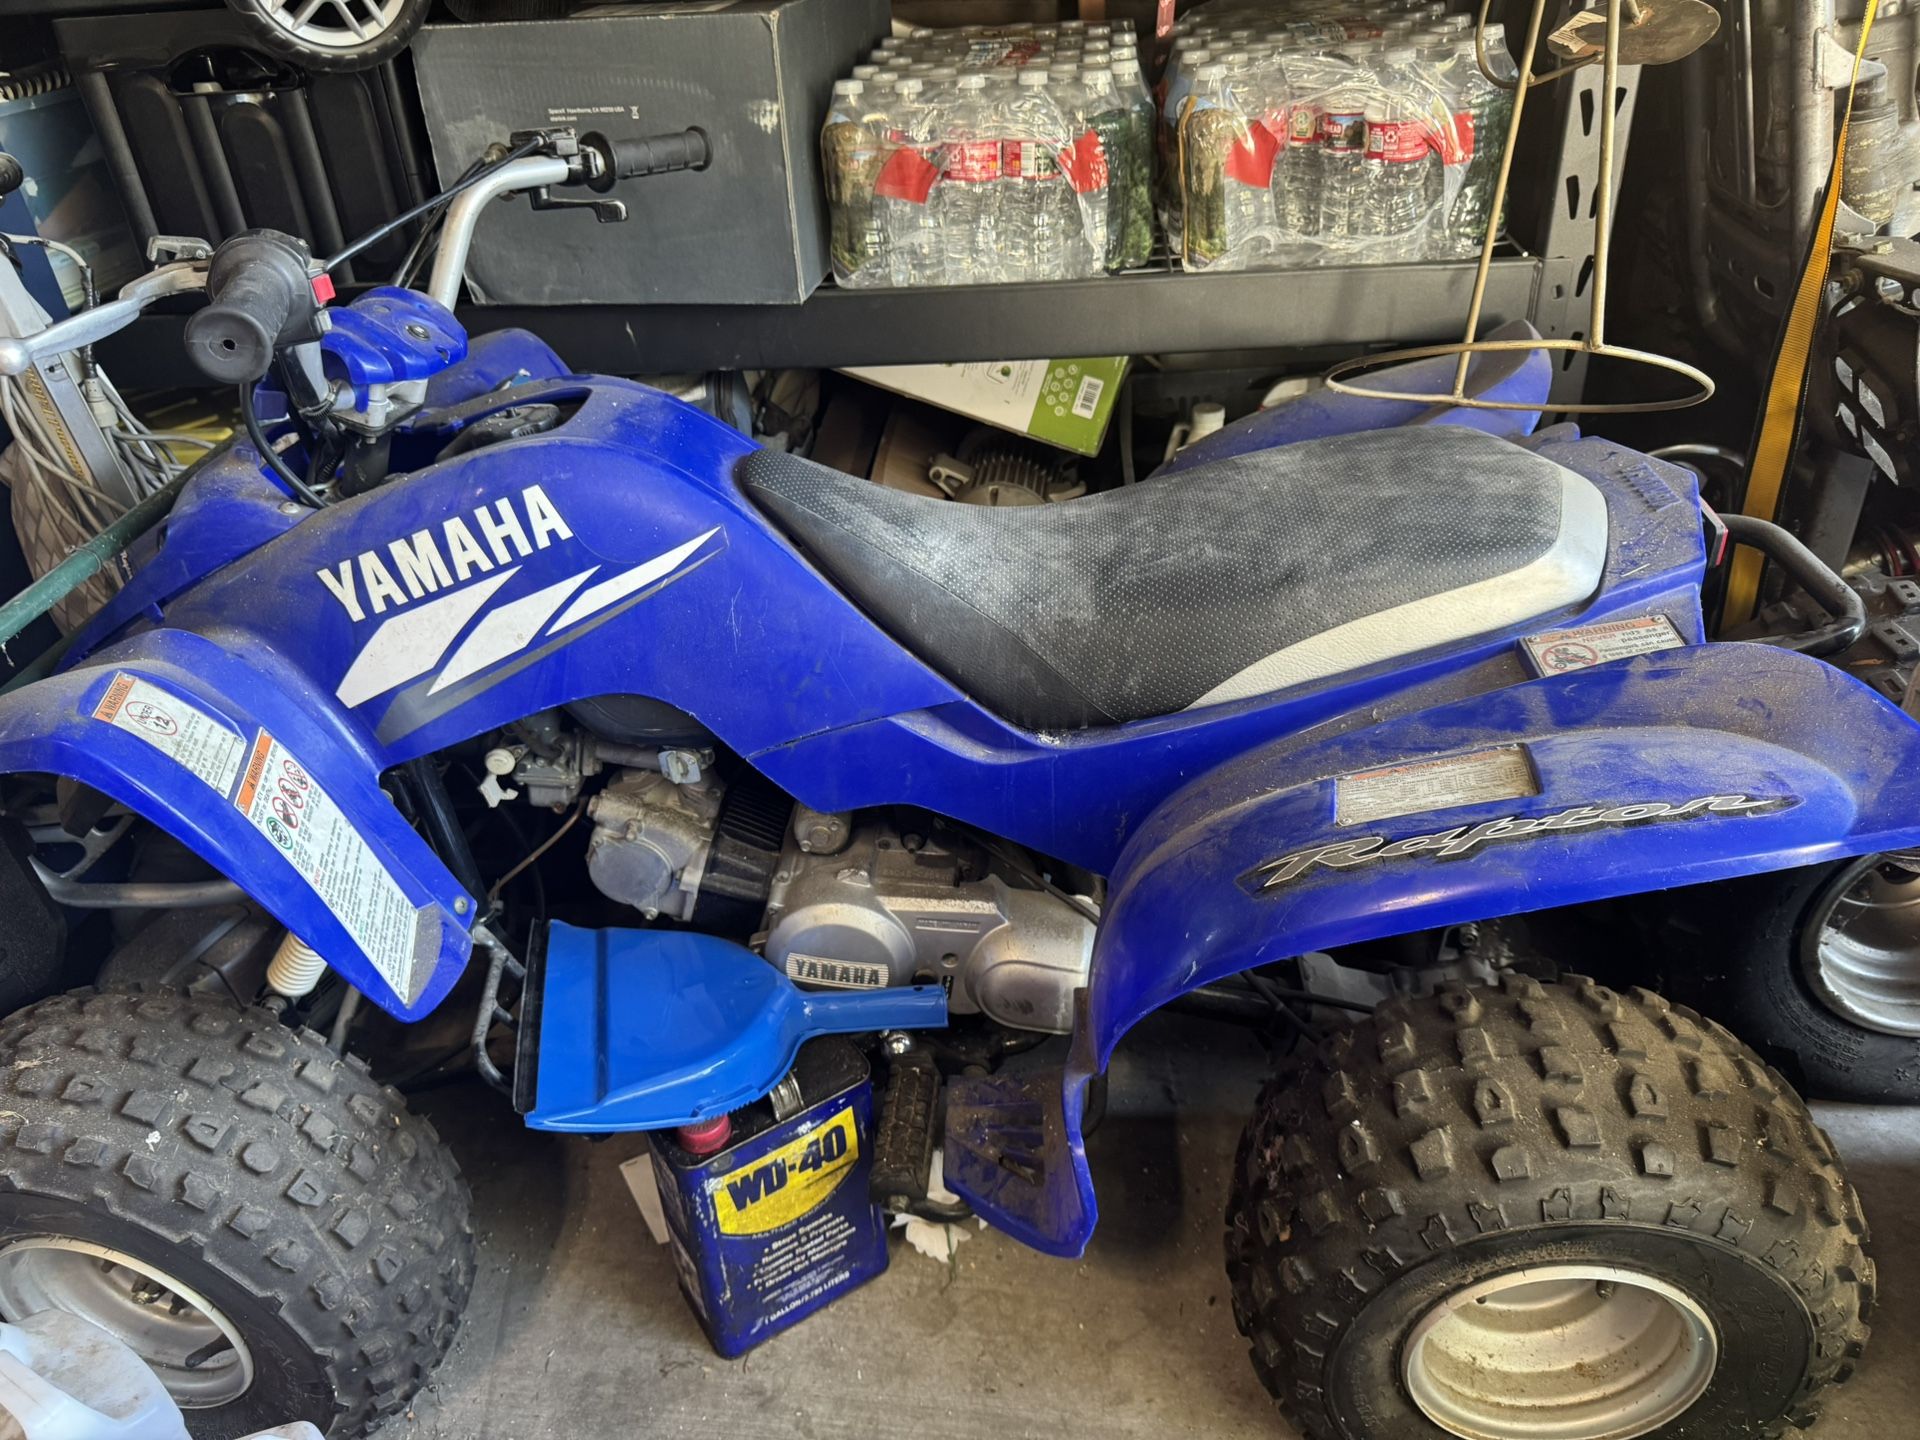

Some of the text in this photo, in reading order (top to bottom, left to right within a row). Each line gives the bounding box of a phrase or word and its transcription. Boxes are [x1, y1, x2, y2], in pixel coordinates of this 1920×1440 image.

[316, 484, 574, 622] YAMAHA
[1572, 621, 1636, 638] WARNING
[1583, 633, 1616, 643] NEVER
[109, 682, 129, 711] WARNING
[138, 704, 153, 724] UNDER
[153, 715, 170, 730] 12
[250, 750, 265, 782] WARNING
[1259, 795, 1776, 886] Raptor
[794, 958, 880, 985] YAMAHA
[726, 1125, 847, 1212] WD-40
[772, 1212, 833, 1250] Stops Squeaks
[826, 1222, 849, 1238] Parts
